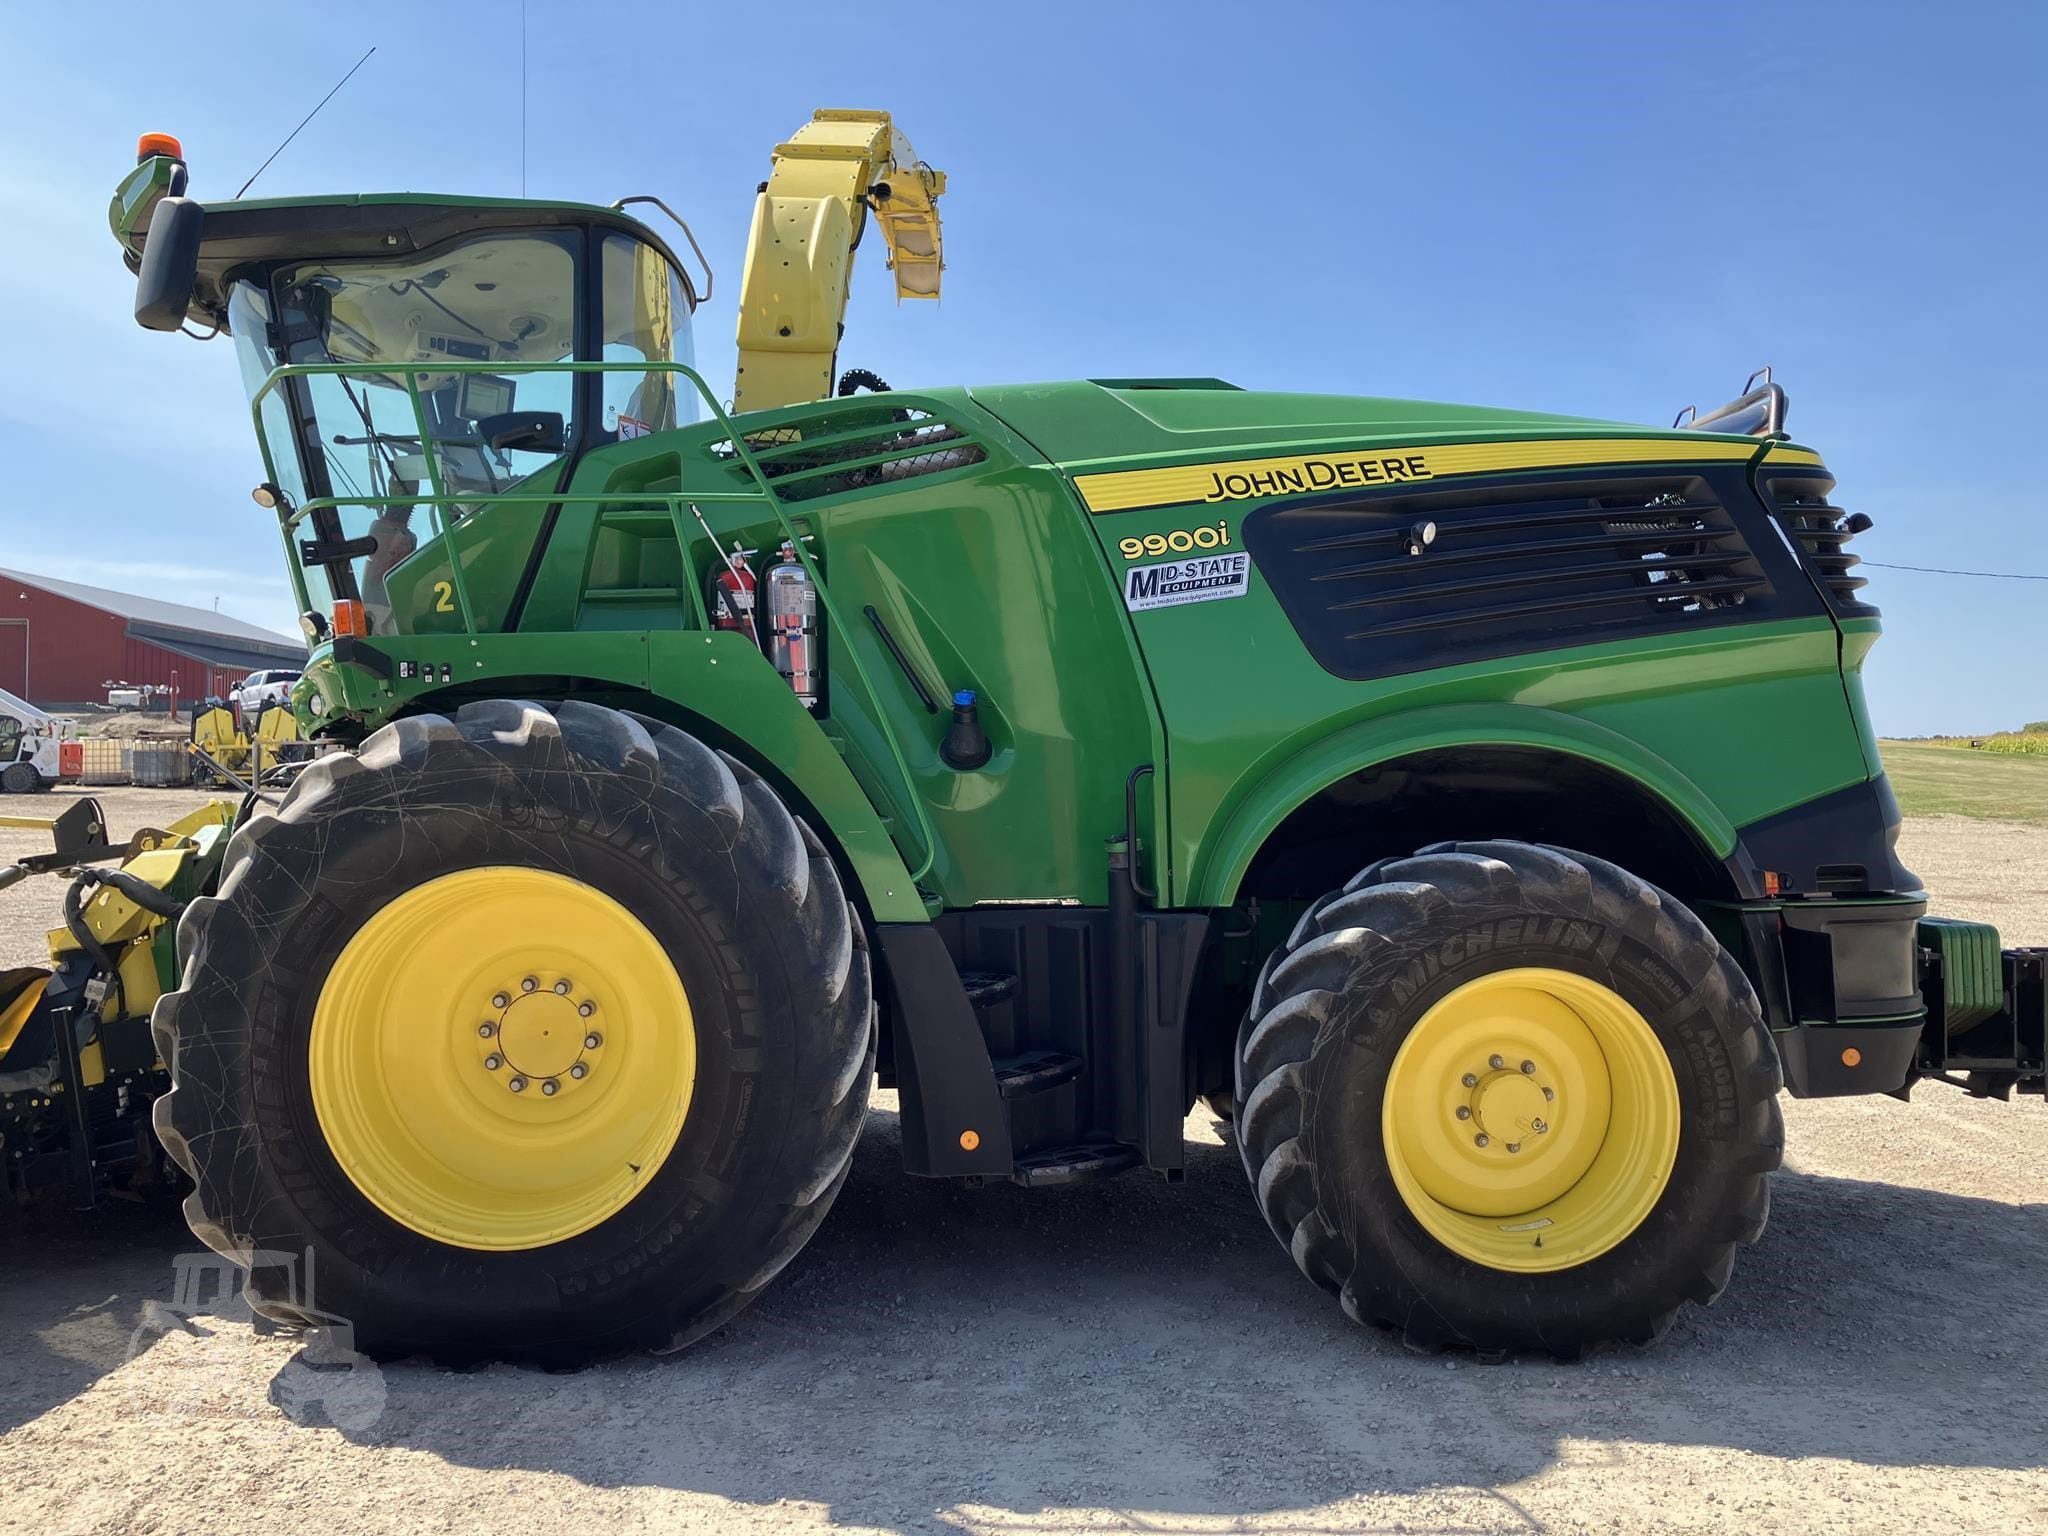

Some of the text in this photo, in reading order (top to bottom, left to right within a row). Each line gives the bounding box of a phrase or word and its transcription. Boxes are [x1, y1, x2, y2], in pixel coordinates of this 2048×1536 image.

[1206, 455, 1432, 500] JOHN DEERE
[1118, 519, 1232, 560] 9900i
[433, 581, 455, 613] 2
[1130, 555, 1246, 600] MID-STATE
[1164, 575, 1234, 593] EQUIPMENT
[1391, 915, 1604, 1001] MICHELIN
